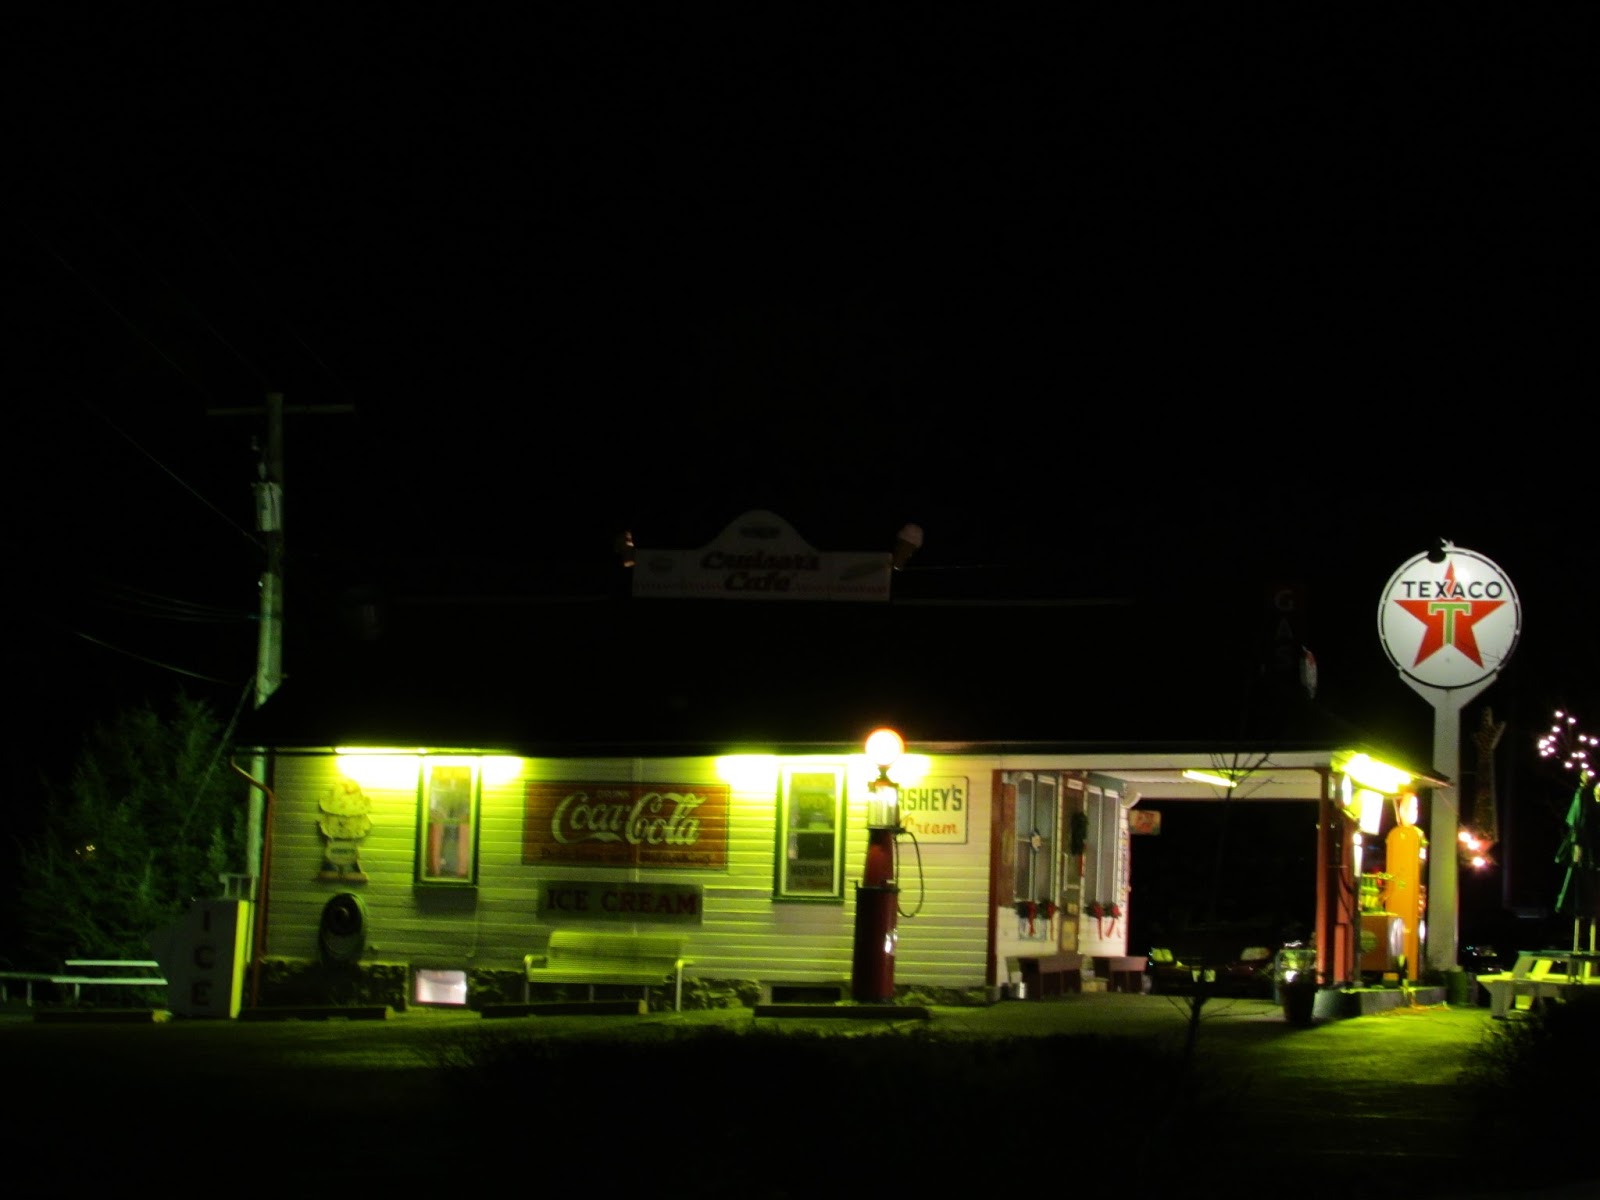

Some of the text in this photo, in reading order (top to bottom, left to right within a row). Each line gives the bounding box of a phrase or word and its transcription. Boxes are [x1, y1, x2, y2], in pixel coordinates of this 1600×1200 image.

[1402, 581, 1503, 598] TEXACO
[546, 889, 698, 915] ICE CREAM
[192, 910, 216, 1005] ICE
